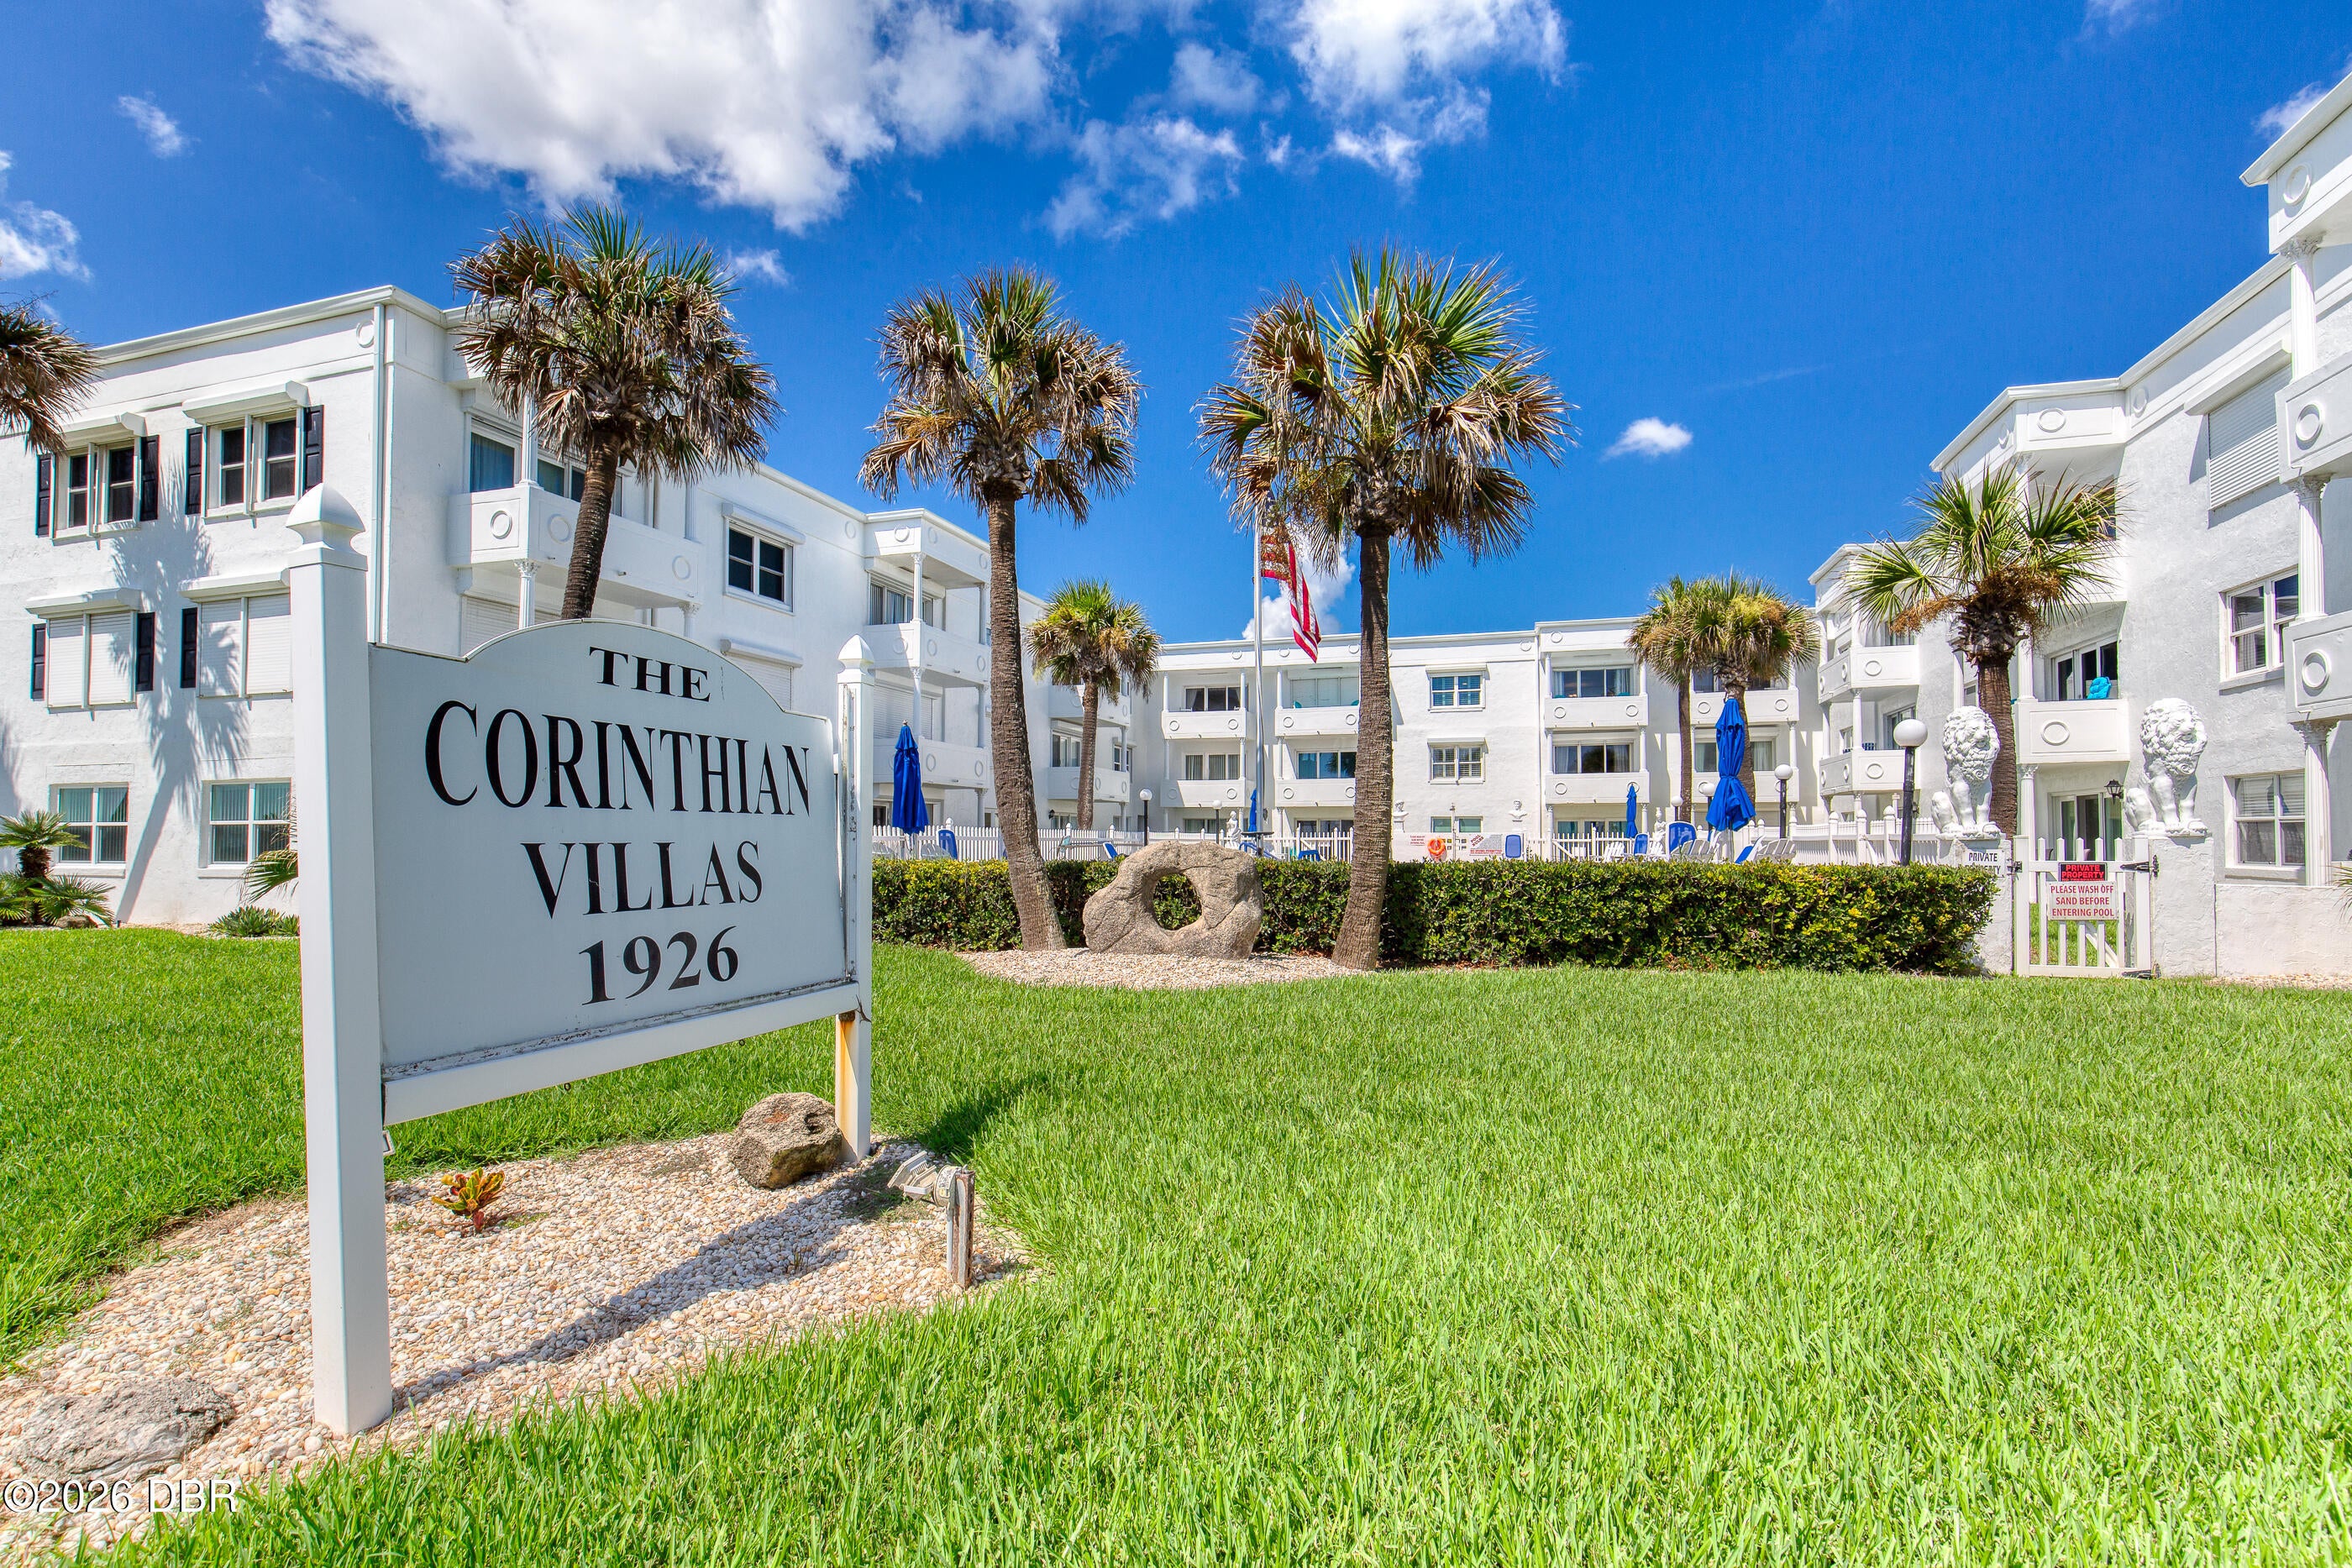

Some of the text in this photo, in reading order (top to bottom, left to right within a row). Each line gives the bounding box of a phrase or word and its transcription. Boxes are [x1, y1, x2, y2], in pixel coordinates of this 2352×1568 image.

[589, 646, 711, 703] THE
[424, 700, 811, 817] CORINTHIAN
[1968, 852, 1998, 862] PRIVATE
[520, 840, 764, 920] VILLAS
[2050, 884, 2114, 894] PLEASE WASH OFF
[2052, 908, 2114, 916] ENTERING POOL
[2055, 897, 2109, 905] SAND BEFORE
[578, 926, 740, 1007] 1926
